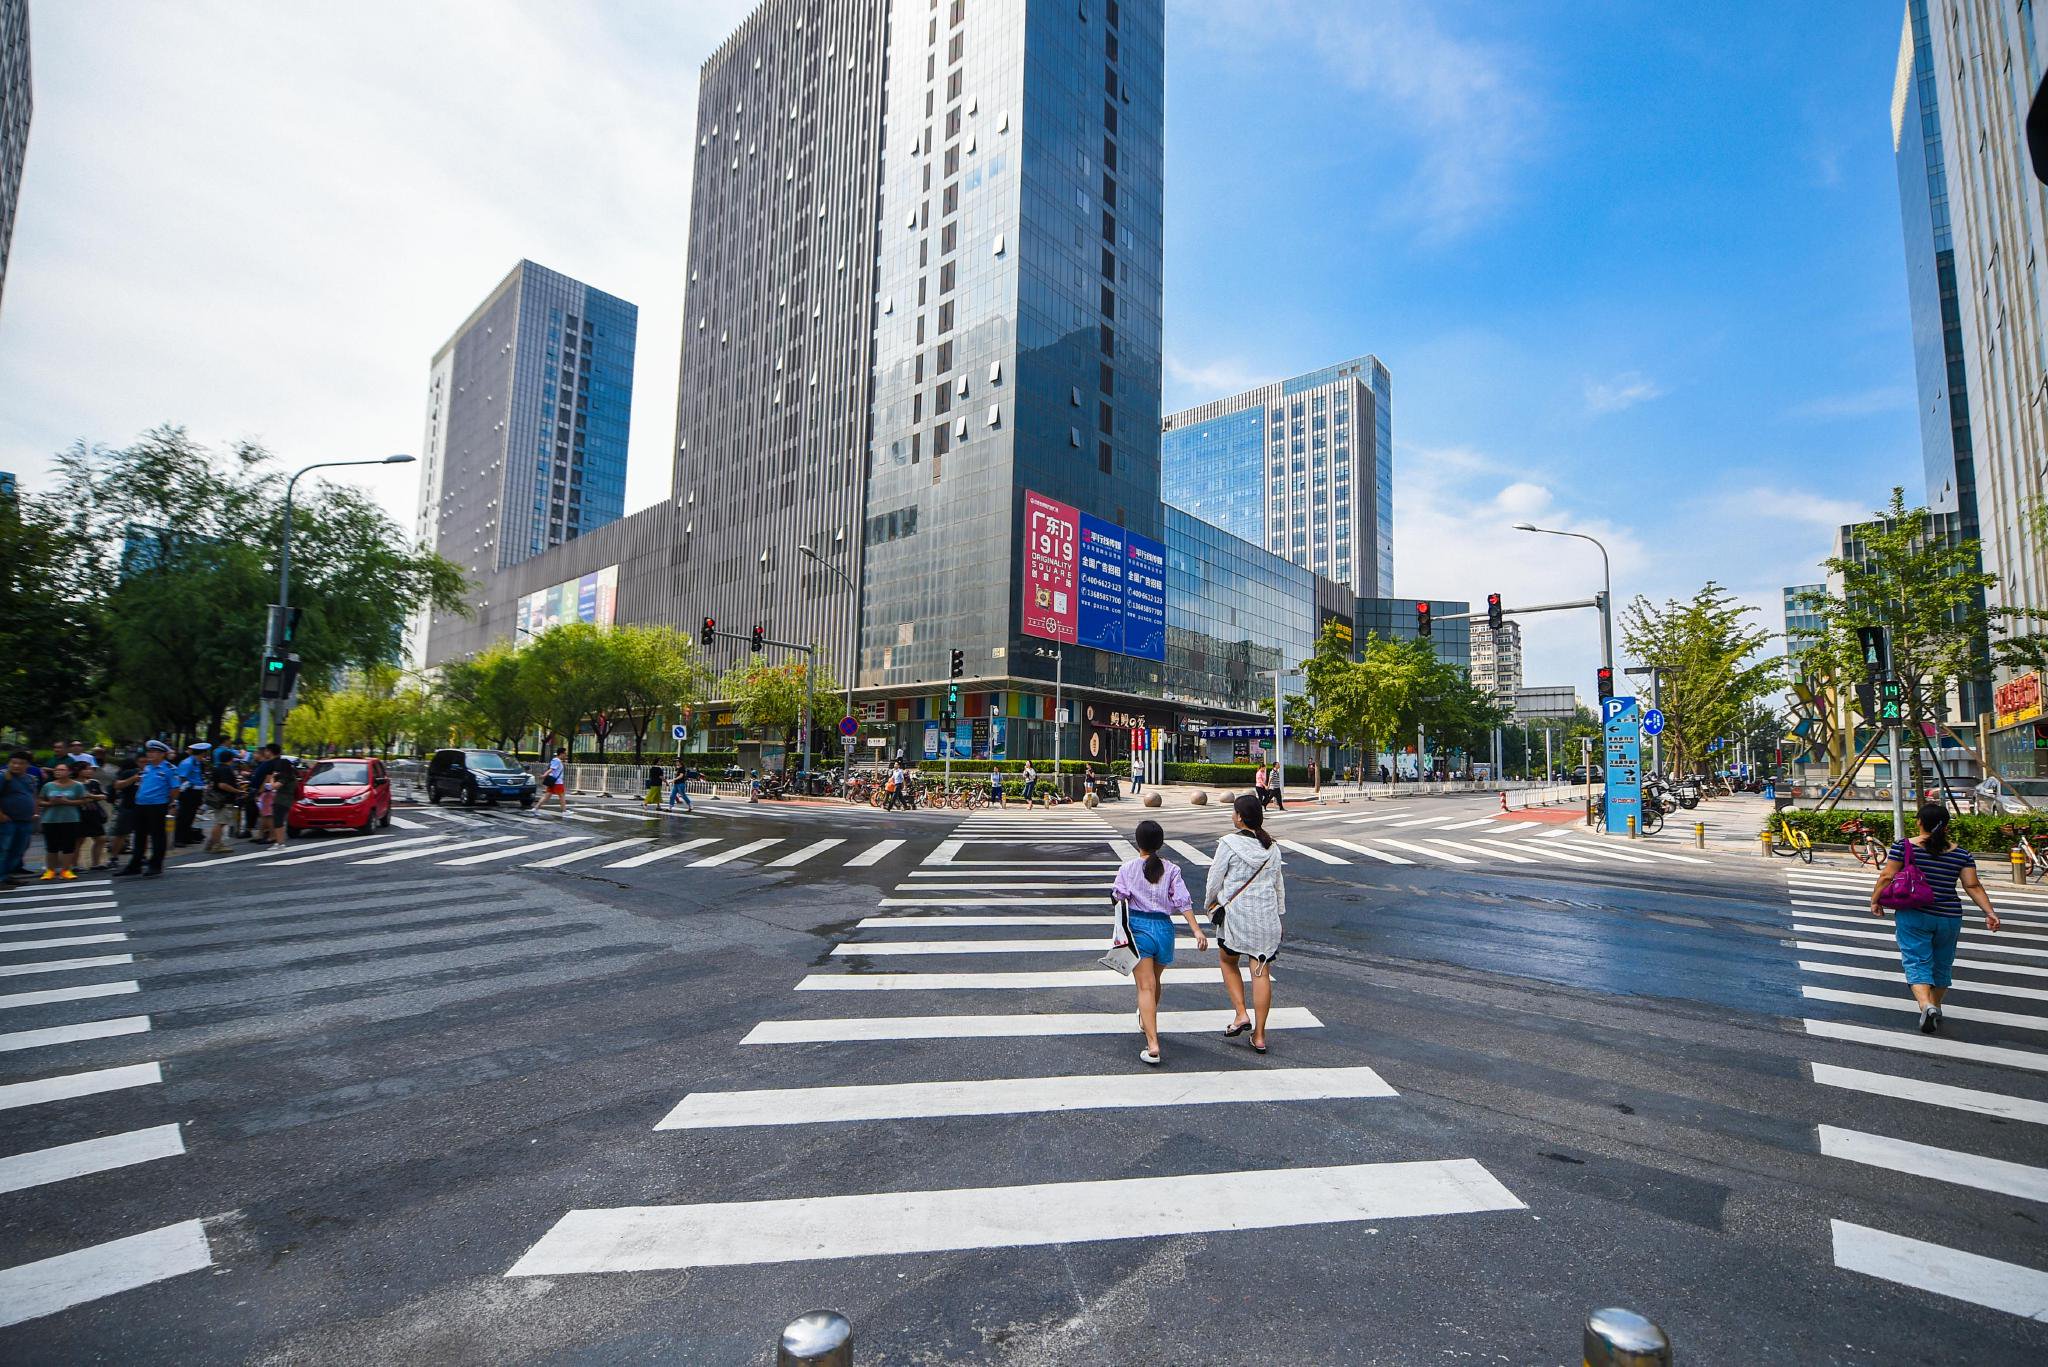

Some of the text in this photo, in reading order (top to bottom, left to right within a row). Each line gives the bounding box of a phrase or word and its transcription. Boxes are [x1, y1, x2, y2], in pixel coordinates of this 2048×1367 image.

[1032, 531, 1073, 561] 1919
[1032, 552, 1072, 571] ORIGINALITY
[1082, 556, 1121, 577] 全国广告招租
[1128, 571, 1163, 591] 全国广告招租
[1885, 686, 1898, 696] 14
[1609, 702, 1622, 718] P
[1201, 728, 1287, 738] 万达广场地下停车
